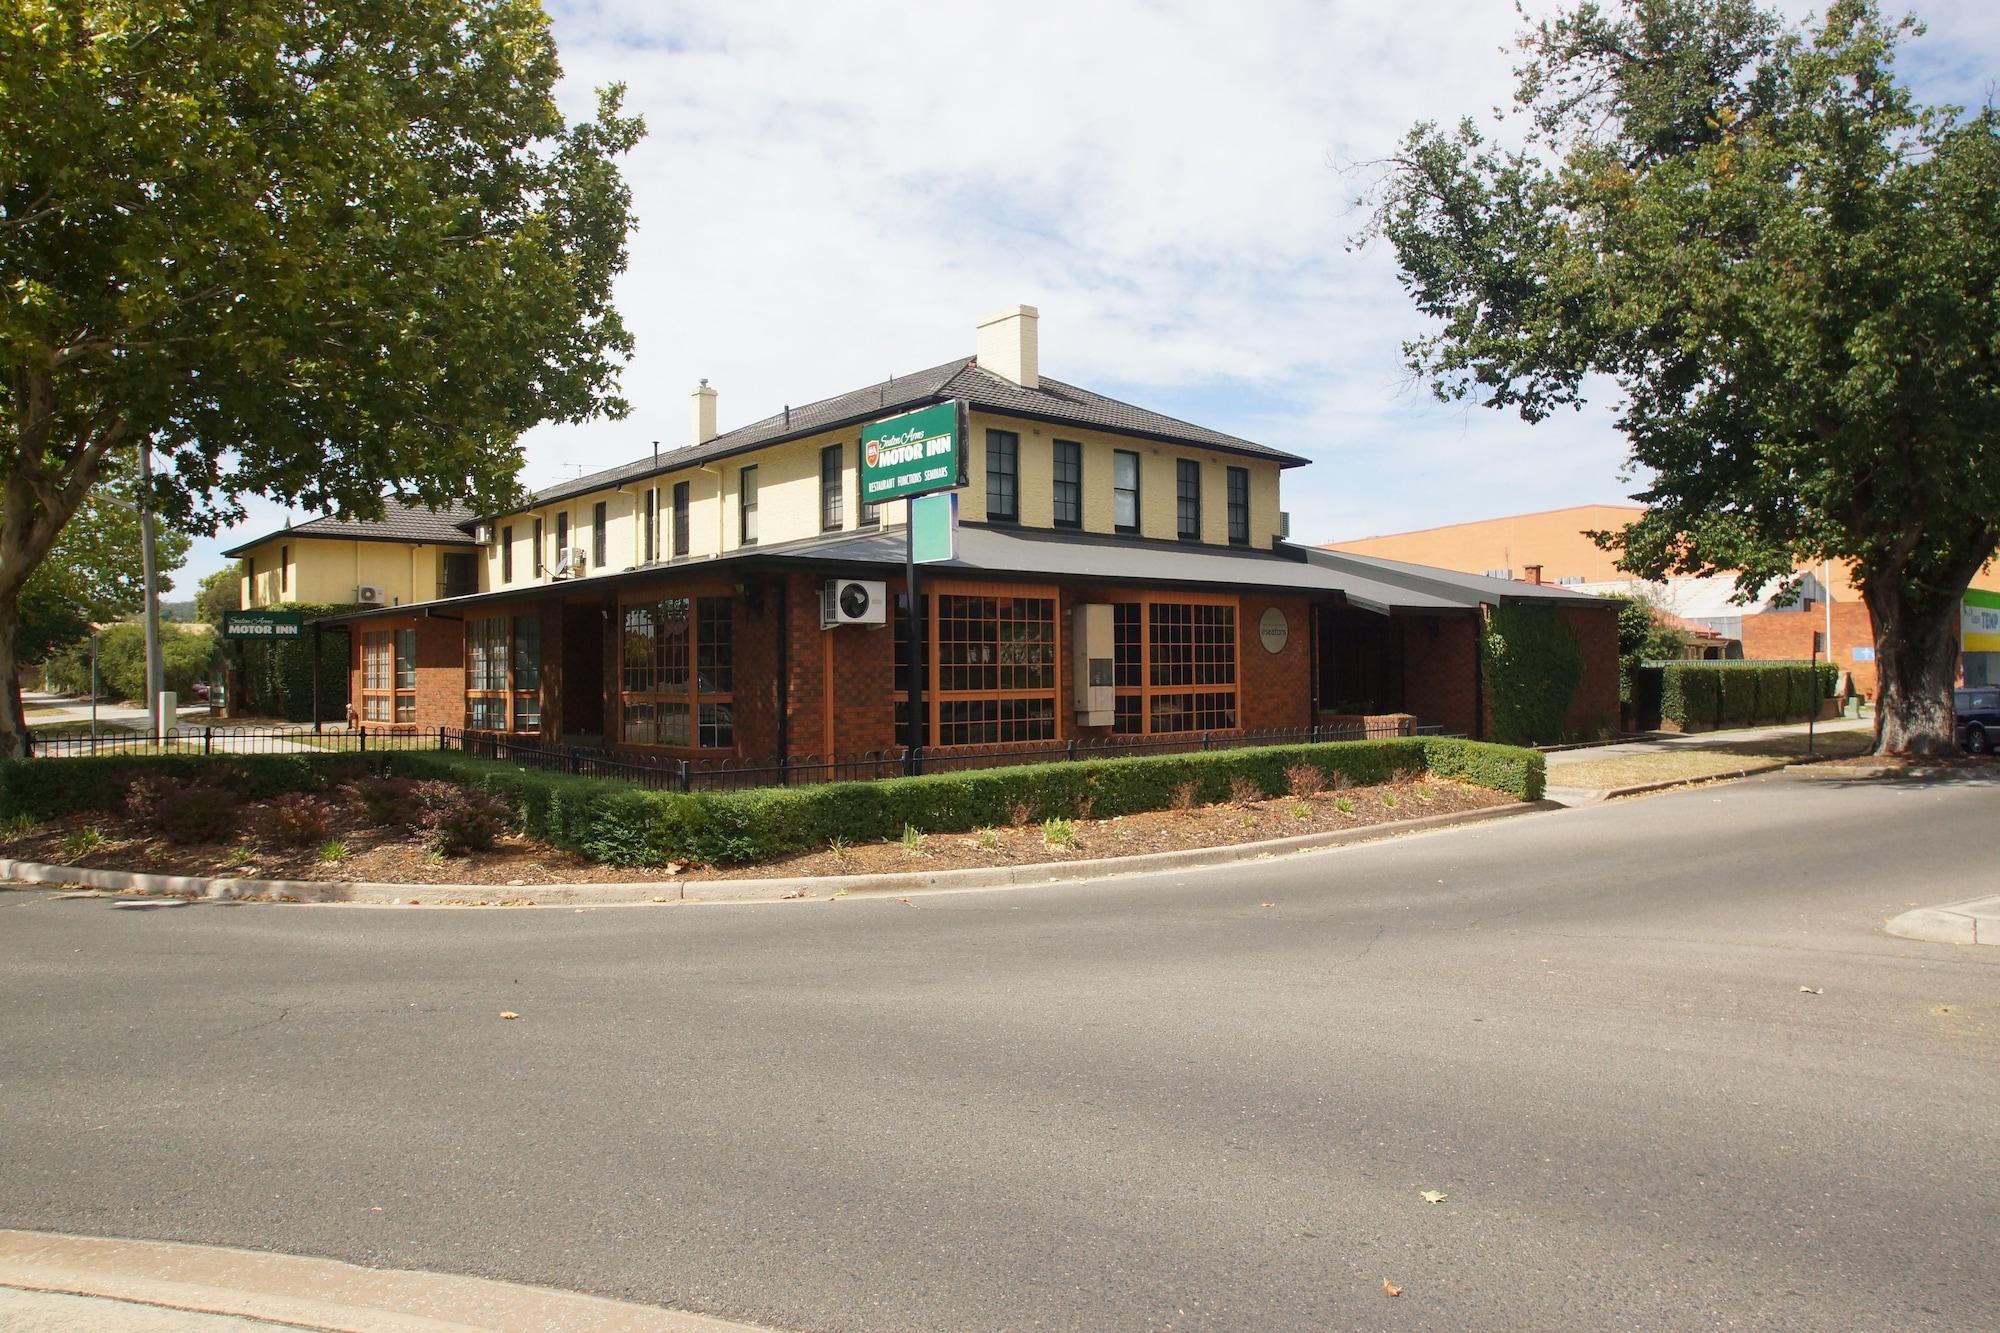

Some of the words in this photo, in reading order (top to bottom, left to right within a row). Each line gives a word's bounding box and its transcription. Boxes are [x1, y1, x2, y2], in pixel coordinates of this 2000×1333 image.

[901, 428, 925, 444] Arms
[879, 443, 923, 468] MOTOR
[927, 436, 951, 457] INN
[869, 478, 895, 493] RESTAURANT
[898, 472, 922, 487] FUNCTIONS
[925, 466, 948, 482] SEMINARS
[228, 625, 272, 634] MOTOR
[275, 625, 298, 634] INN
